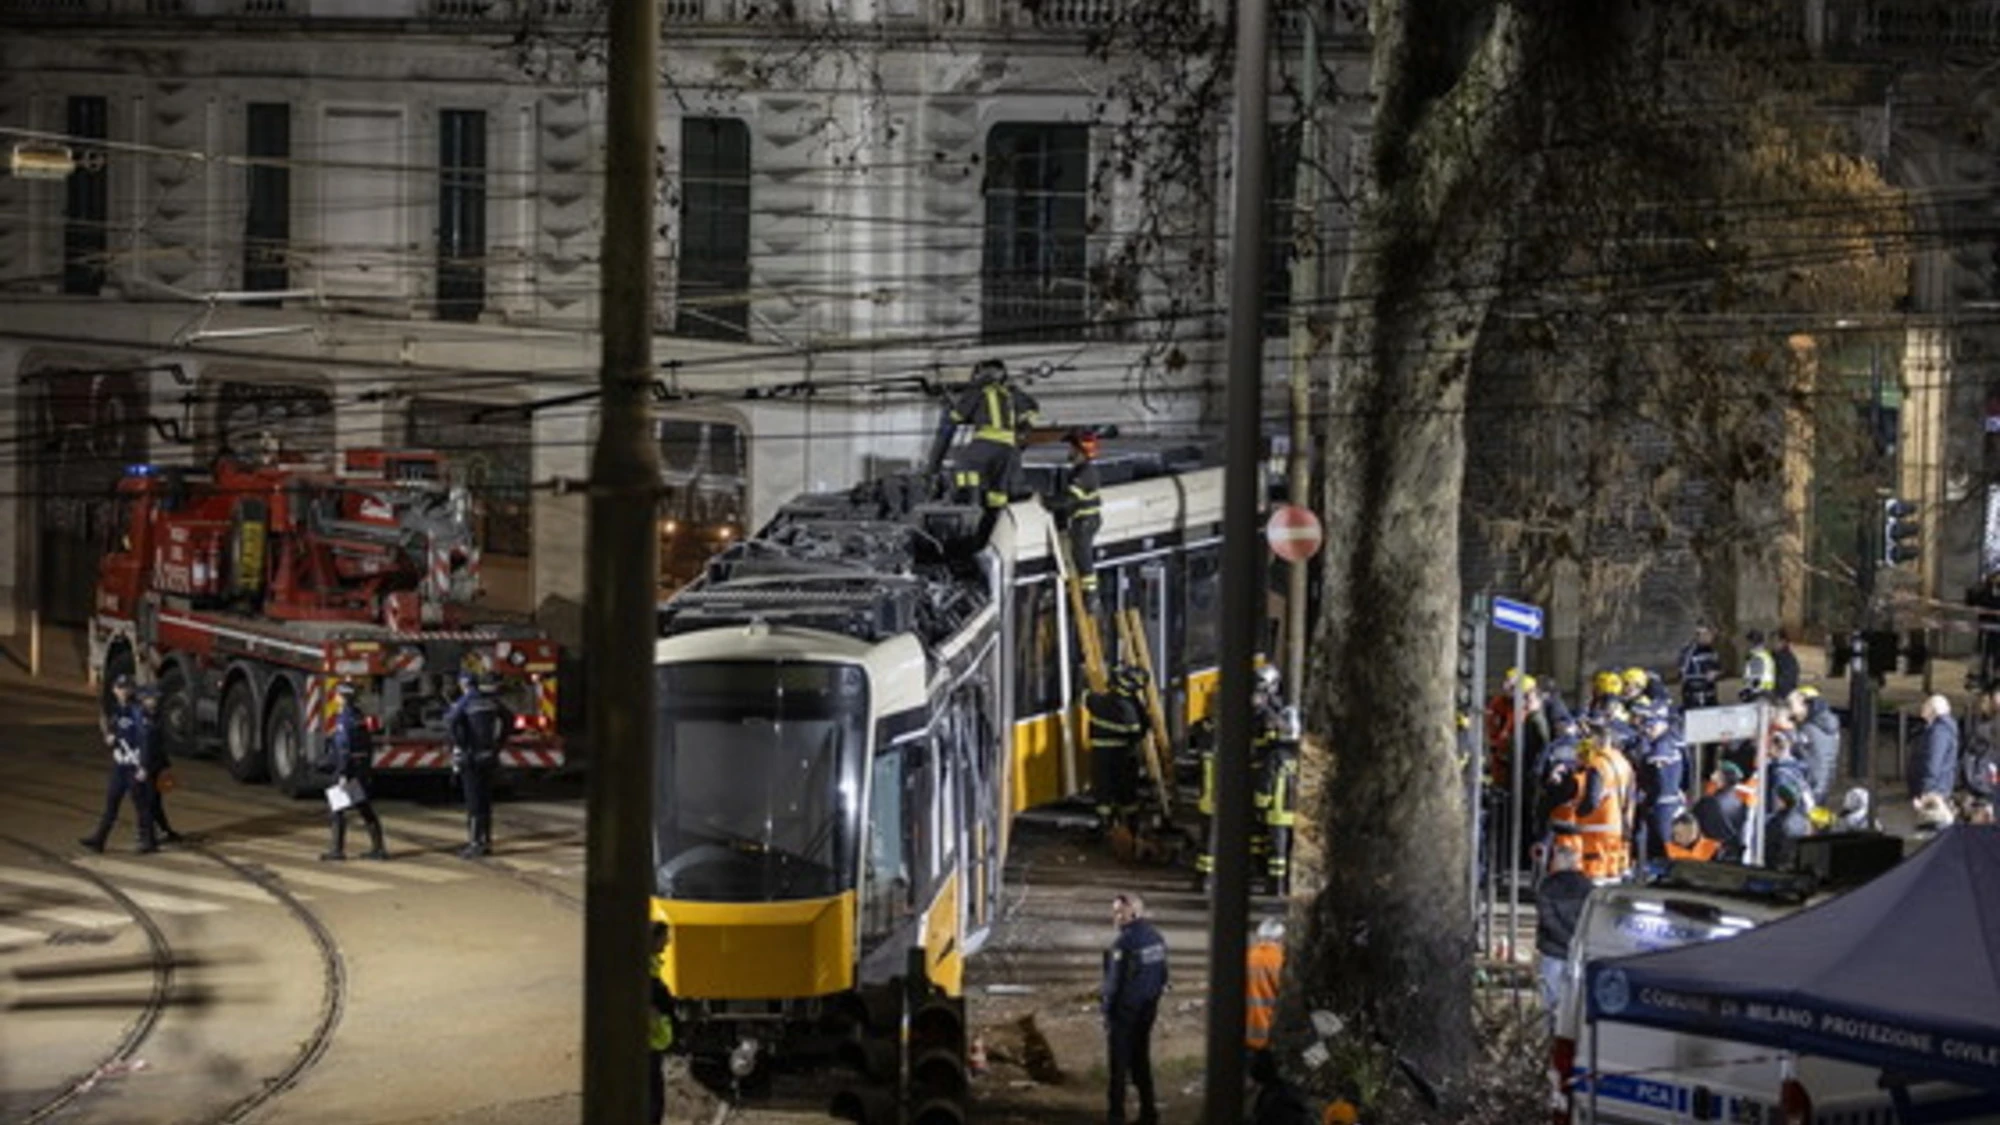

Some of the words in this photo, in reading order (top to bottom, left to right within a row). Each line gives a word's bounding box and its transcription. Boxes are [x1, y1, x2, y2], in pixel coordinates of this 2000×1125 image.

[1638, 987, 1710, 1013] COMUNE
[1720, 1001, 1738, 1017] DI
[1747, 1003, 1811, 1029] MILANO
[1820, 1013, 1933, 1054] PROTEZIONE
[1941, 1037, 1999, 1067] CIVILE
